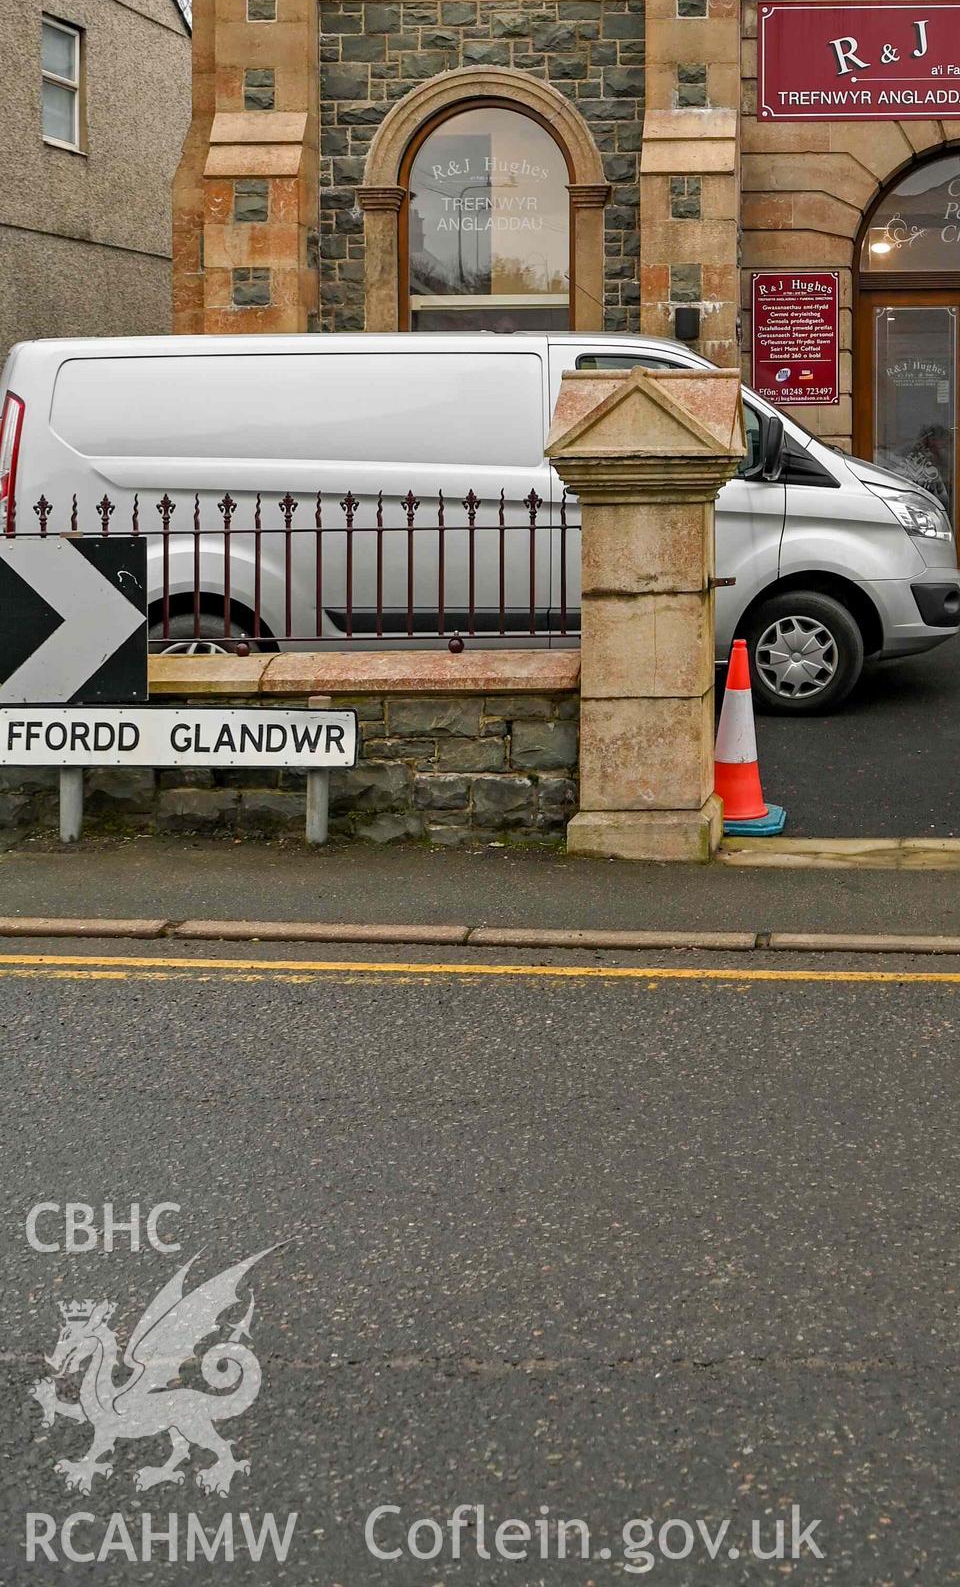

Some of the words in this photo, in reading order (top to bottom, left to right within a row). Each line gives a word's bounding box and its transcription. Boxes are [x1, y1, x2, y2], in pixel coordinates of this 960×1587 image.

[829, 36, 871, 75] R
[881, 44, 900, 63] &
[913, 20, 928, 57] J
[778, 91, 871, 105] TREFNWYR
[484, 157, 549, 179] Hughes
[441, 197, 537, 211] TREFNWYR
[437, 217, 543, 231] ANGLADDAU
[759, 285, 768, 294] R
[779, 281, 783, 290] J
[792, 280, 832, 294] Hughes
[7, 721, 140, 751] FFORDD
[170, 723, 345, 754] GLANDWR
